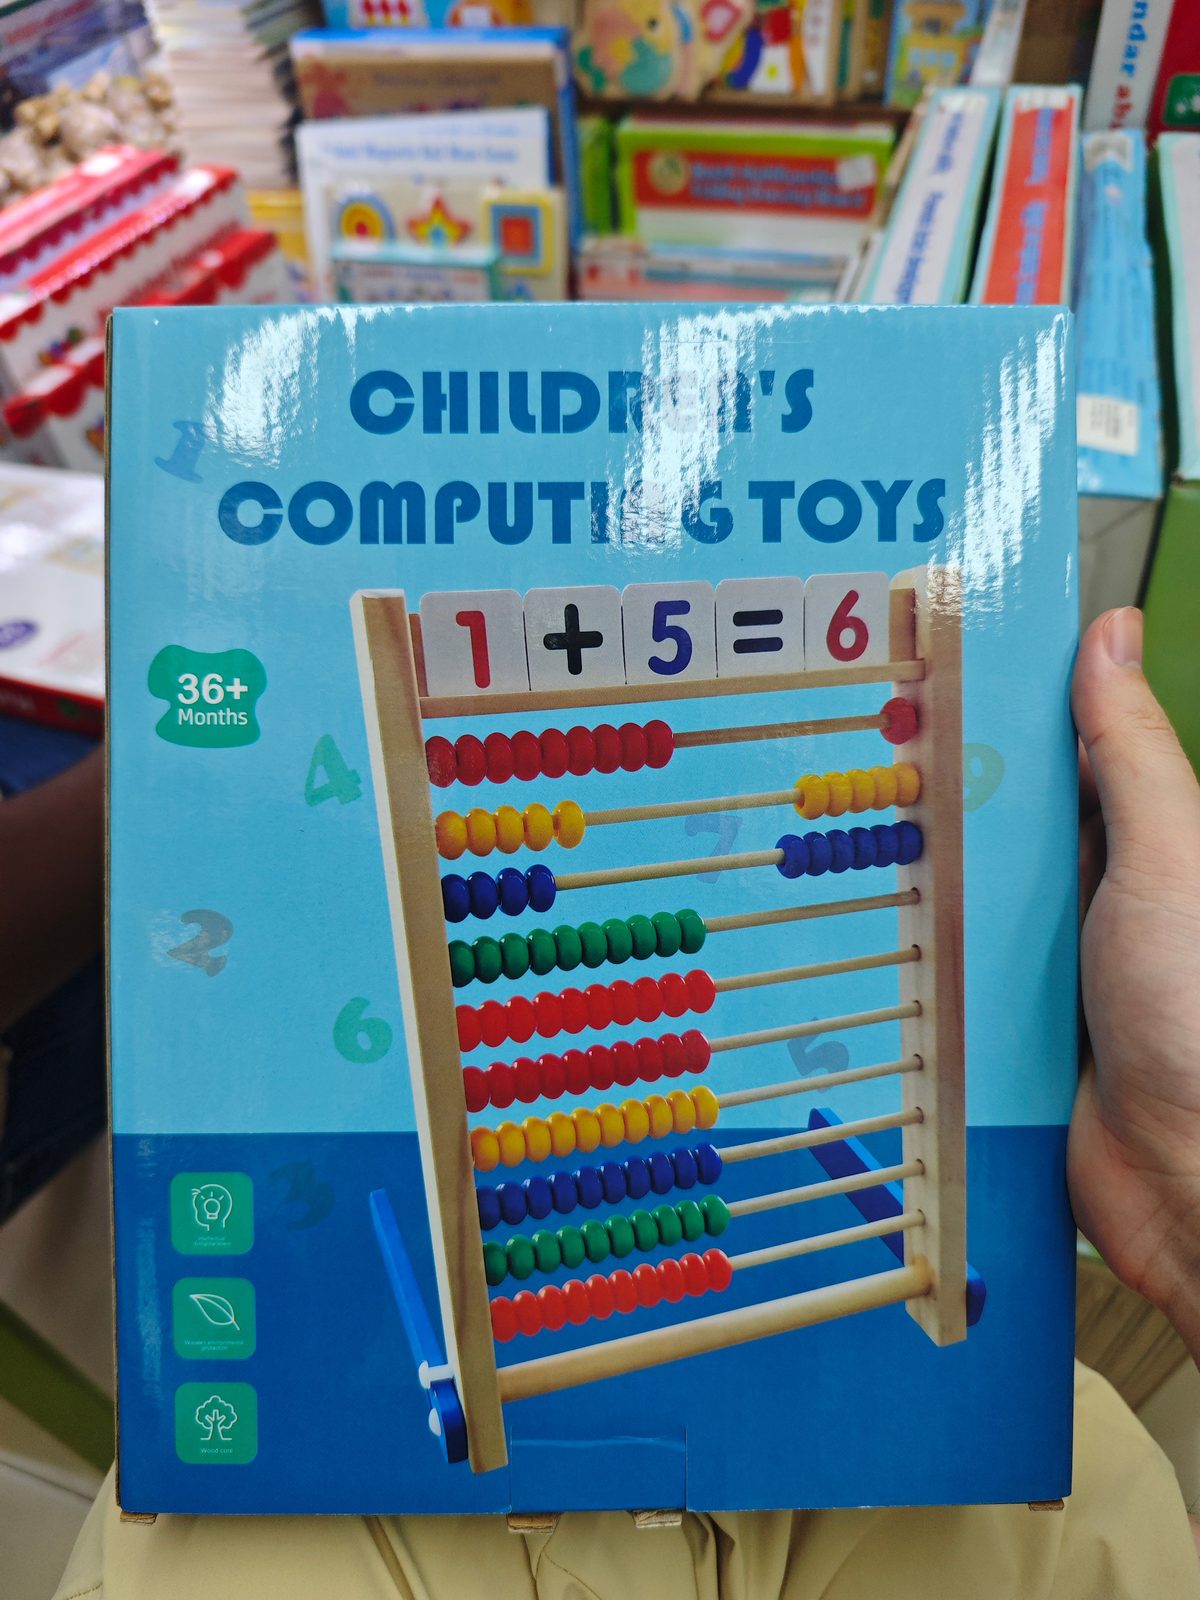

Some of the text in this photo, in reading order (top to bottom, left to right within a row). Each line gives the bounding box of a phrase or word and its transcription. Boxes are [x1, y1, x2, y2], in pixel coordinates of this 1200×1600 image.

[218, 477, 947, 546] COMPUTIG TOYS
[455, 610, 491, 689] 1
[647, 599, 693, 676] 5
[825, 589, 870, 662] 6
[177, 672, 249, 705] 36+
[178, 707, 249, 727] Months
[304, 734, 363, 808] 4
[684, 813, 743, 885] 7
[166, 908, 234, 977] 2
[332, 996, 394, 1065] 6
[266, 1159, 337, 1233] 3
